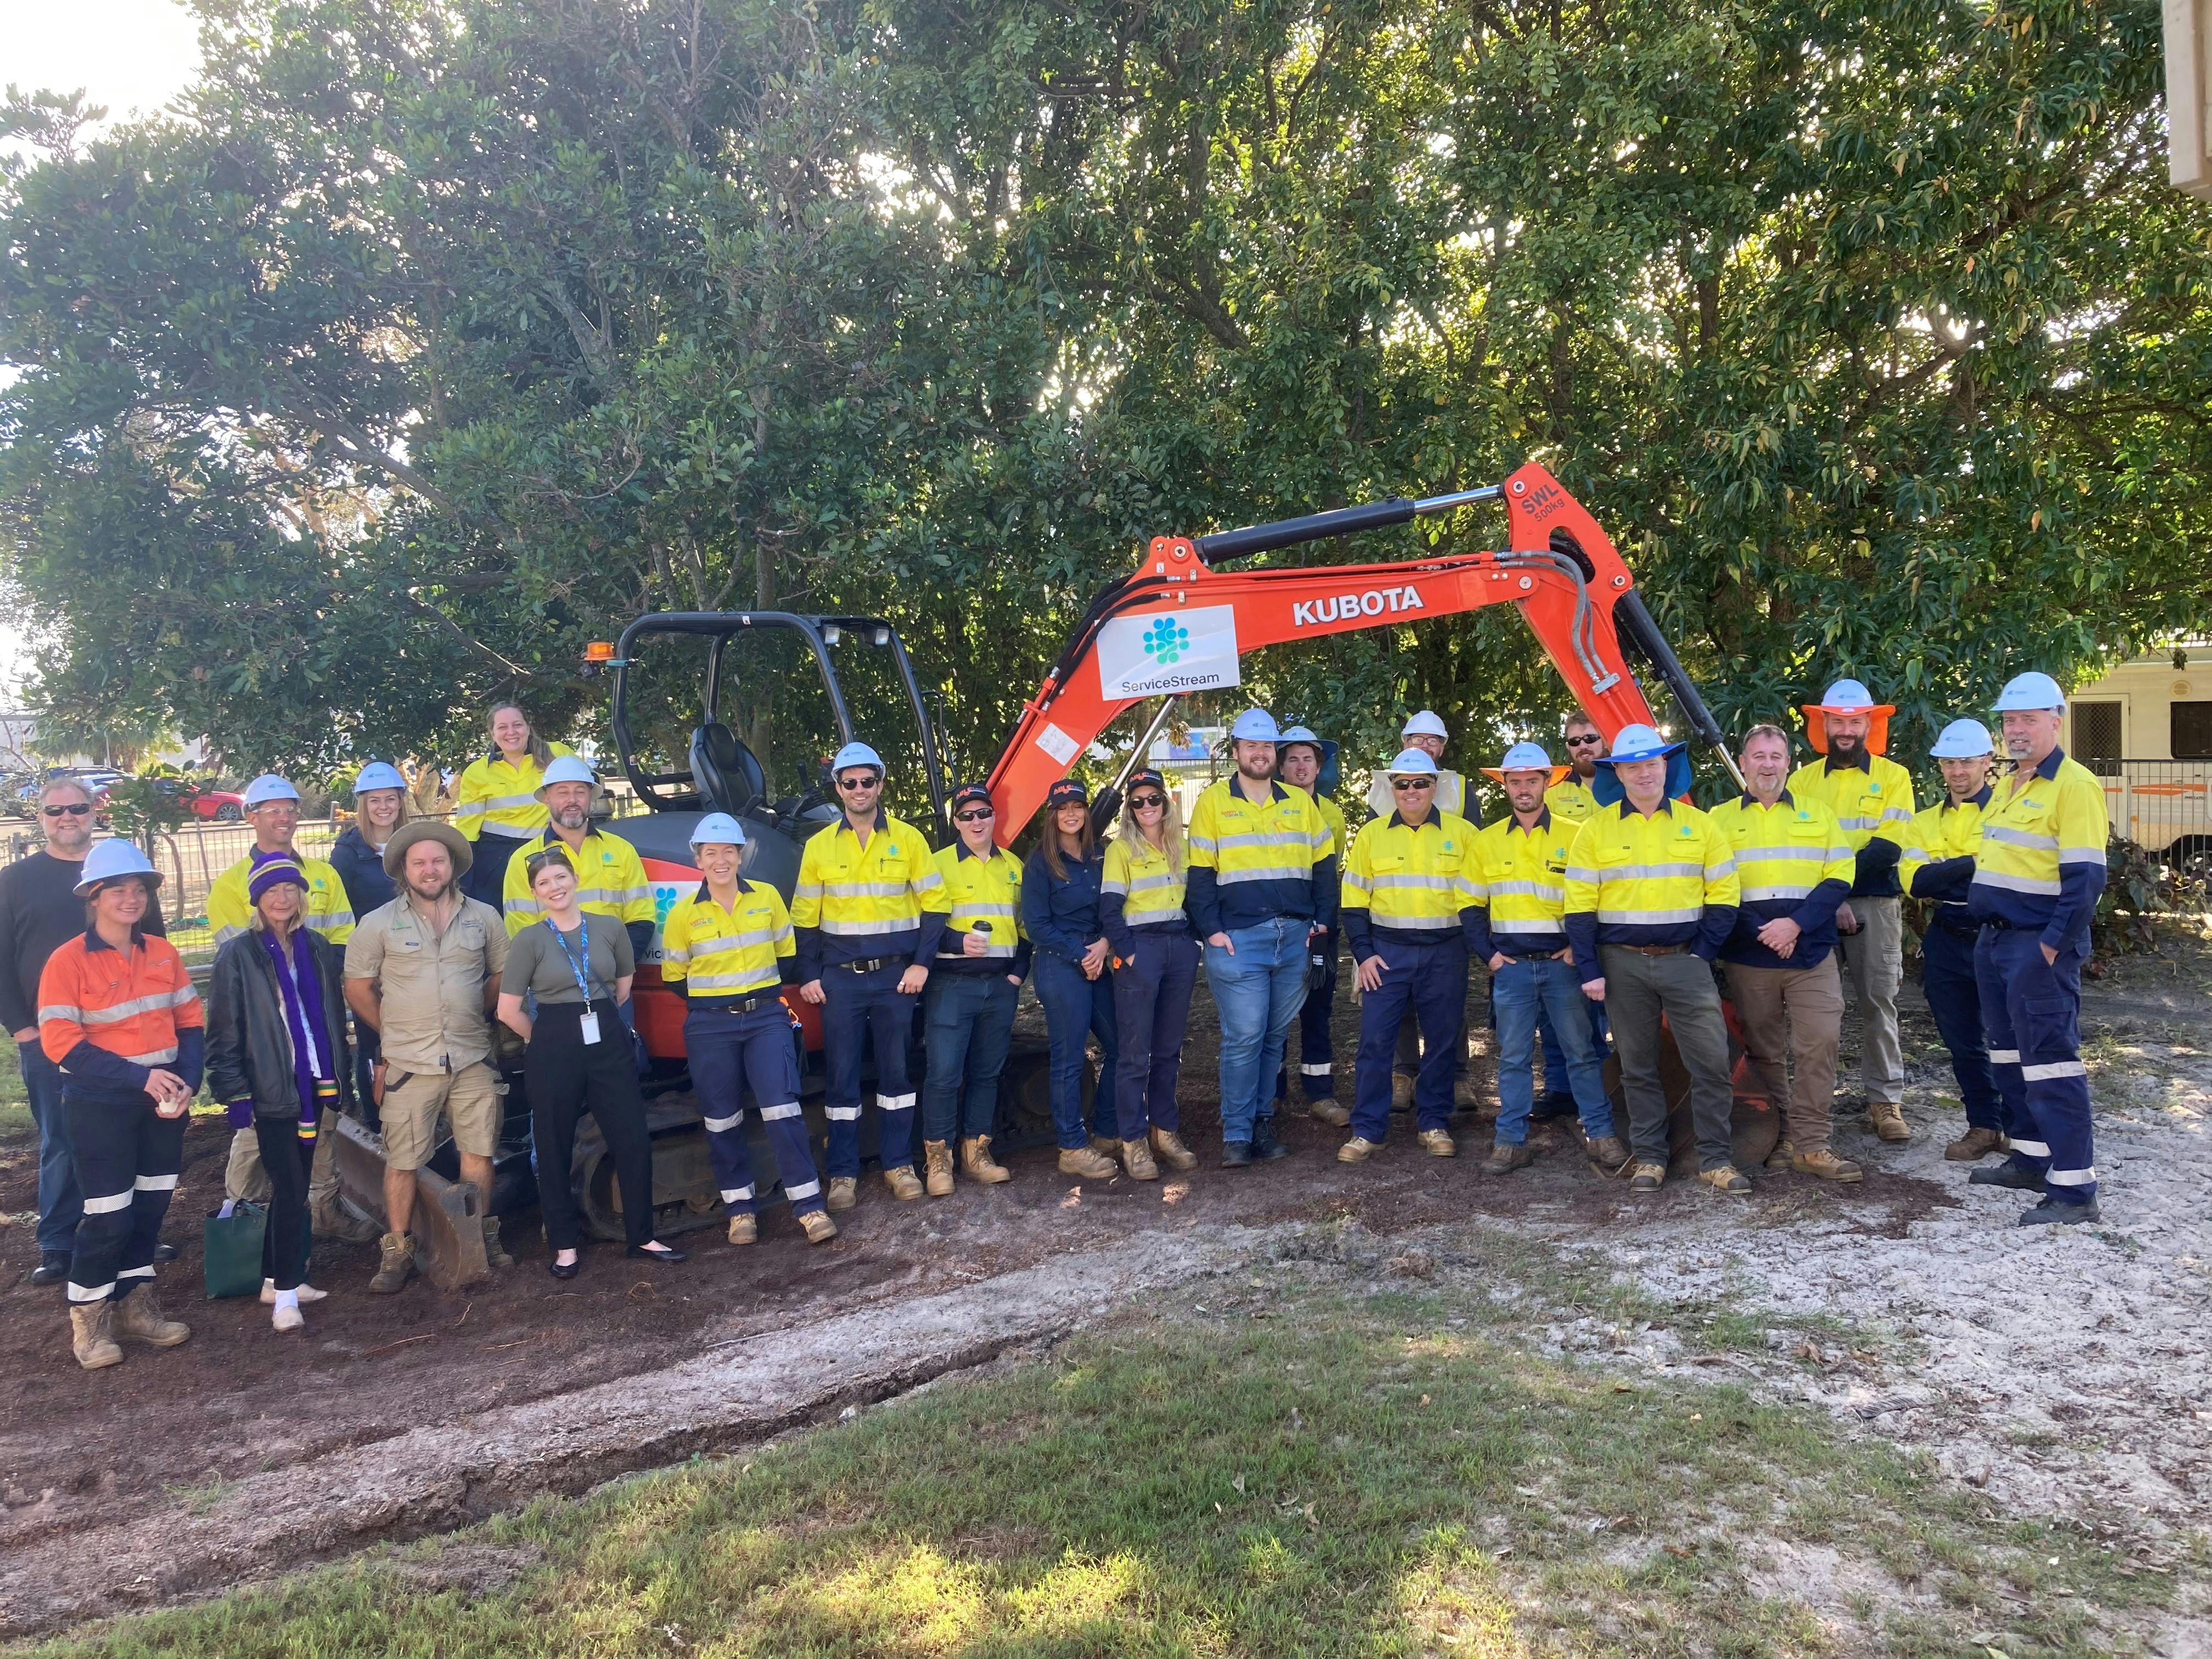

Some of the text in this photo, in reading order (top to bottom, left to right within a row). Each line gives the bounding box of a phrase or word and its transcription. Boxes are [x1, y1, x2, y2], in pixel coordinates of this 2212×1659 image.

[1521, 484, 1559, 514] SWL
[1534, 498, 1565, 522] 500kg
[1293, 585, 1424, 626] KUBOTA
[1122, 674, 1220, 692] ServiceStream
